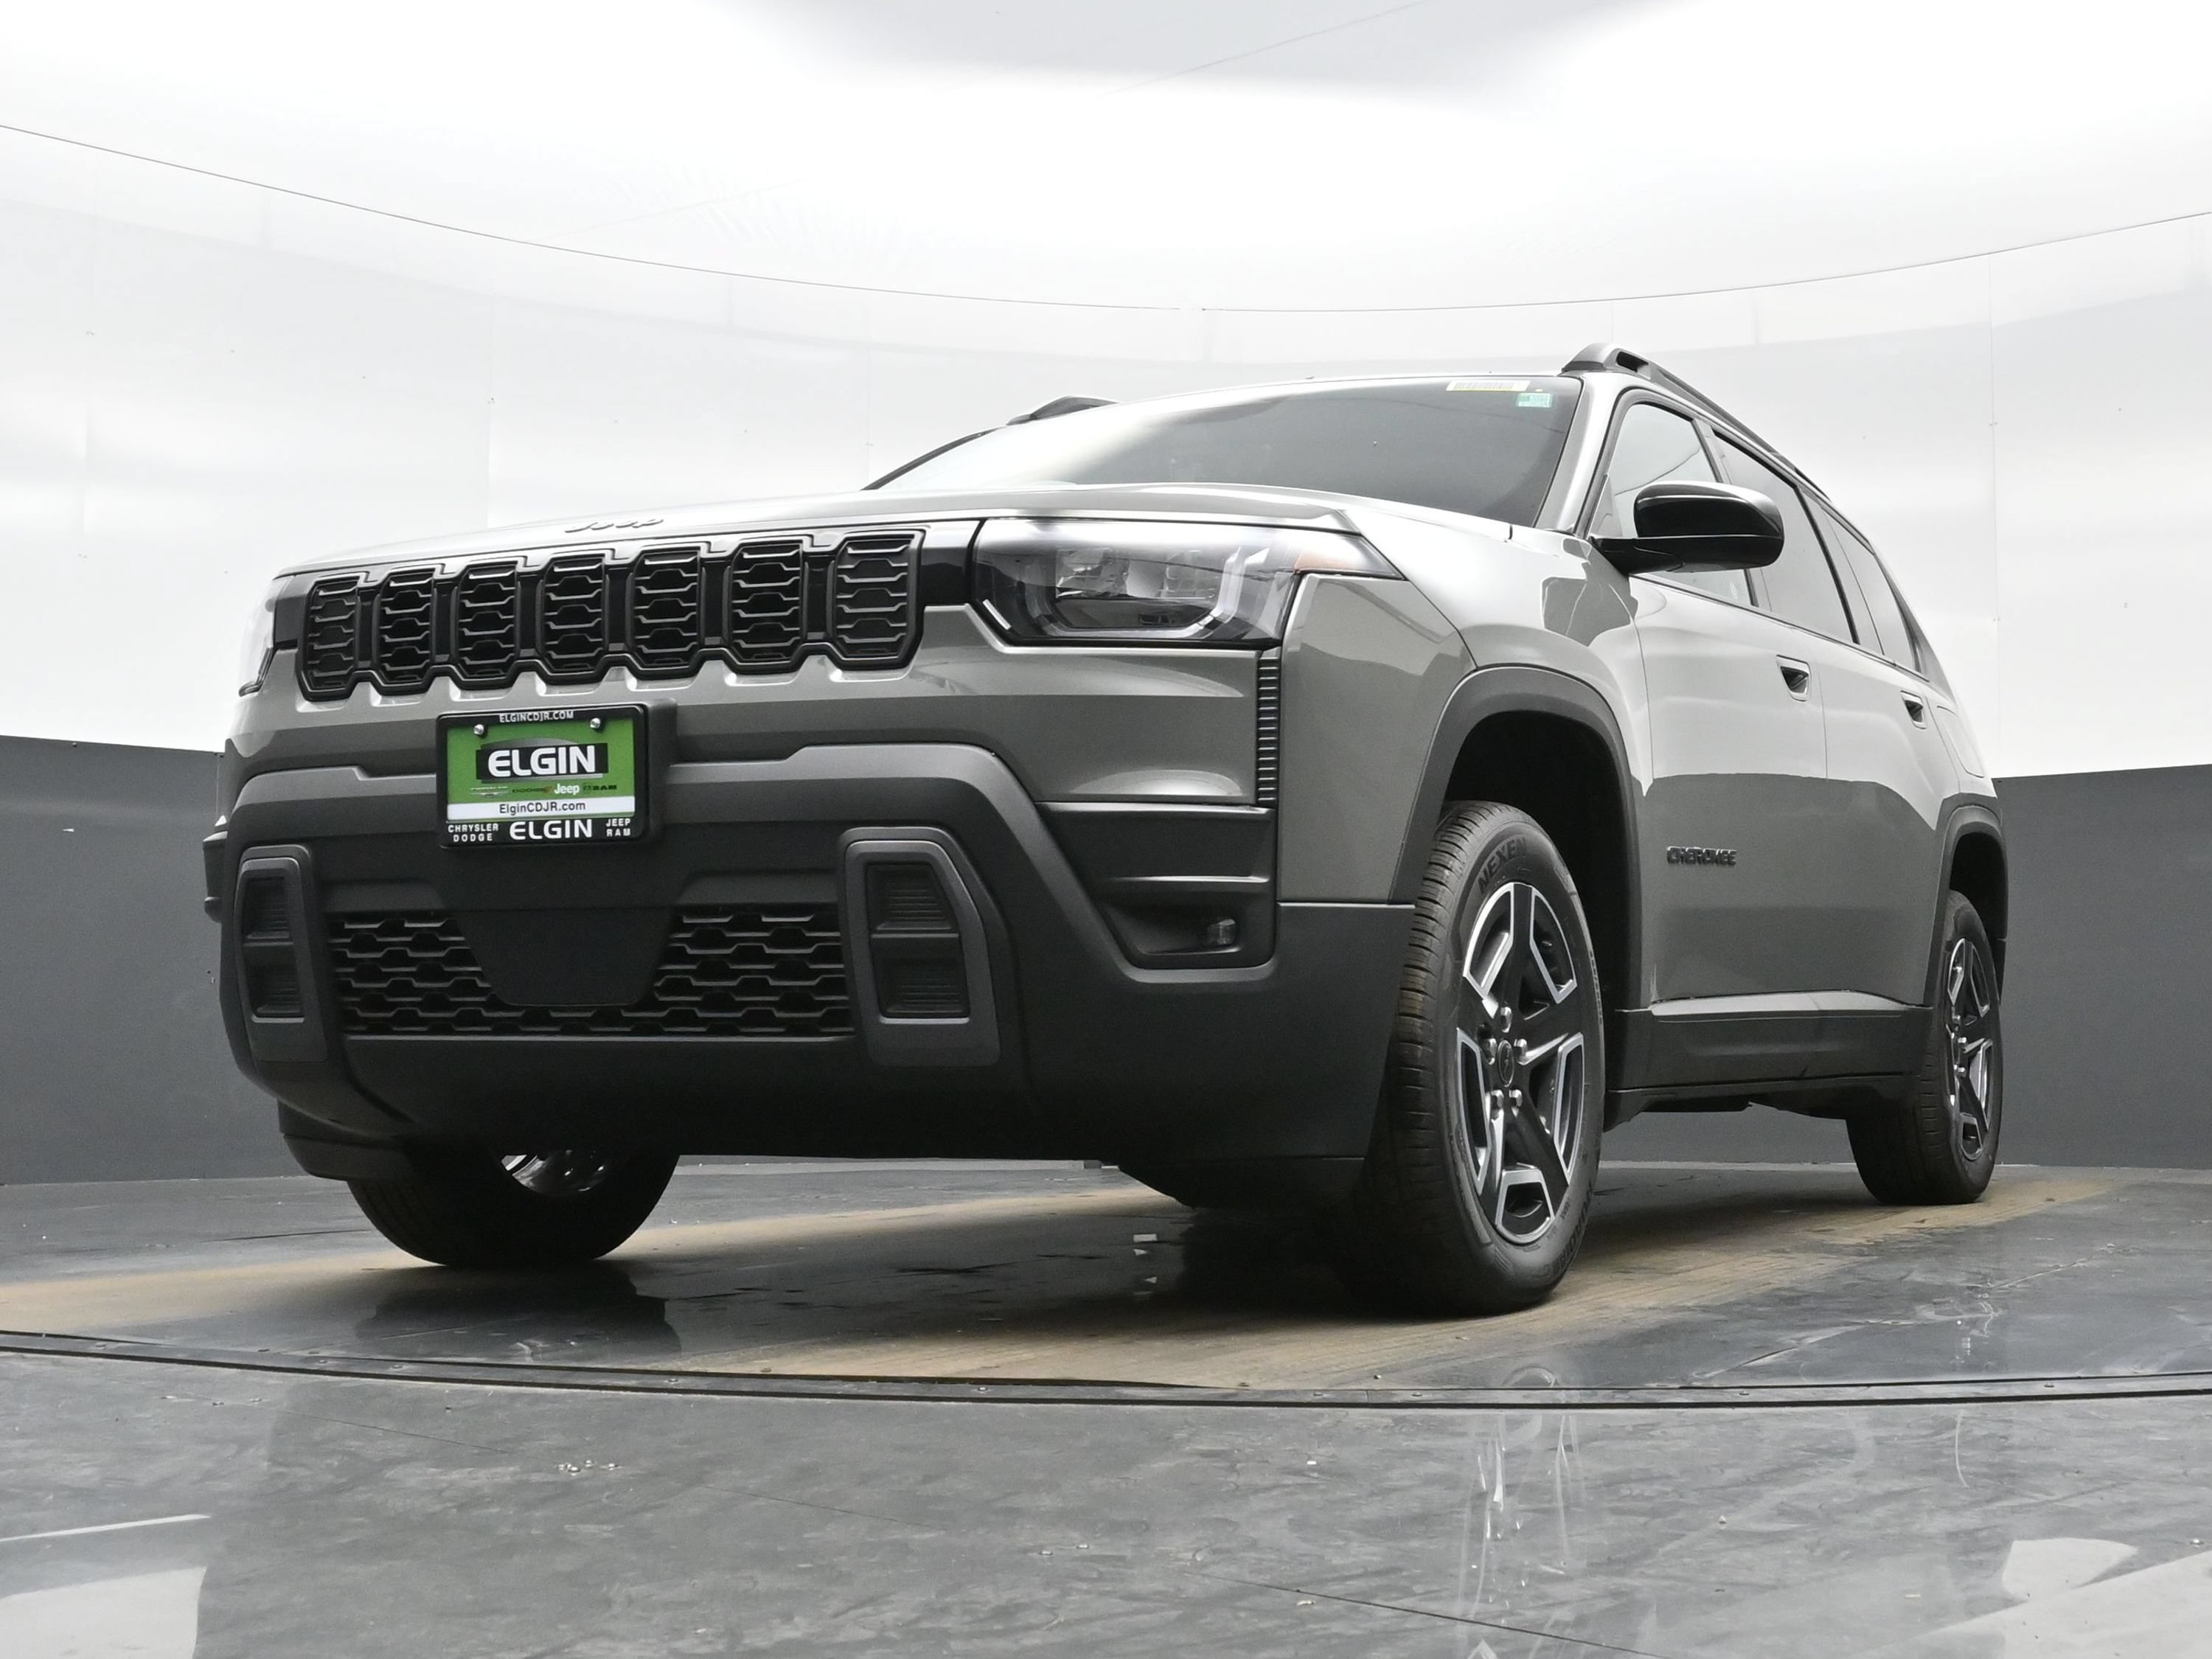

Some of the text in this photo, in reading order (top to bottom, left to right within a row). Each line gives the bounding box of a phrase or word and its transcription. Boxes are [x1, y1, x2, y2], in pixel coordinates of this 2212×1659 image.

[499, 710, 574, 723] ELGINCDJR.COM
[487, 745, 596, 777] ELGIN
[554, 783, 580, 796] Jeep
[499, 801, 586, 815] ElginCDJR.com
[448, 823, 499, 833] CHRYSLER
[605, 818, 631, 827] JEEP
[509, 819, 592, 841] ELGIN
[606, 828, 631, 837] RAM
[453, 833, 493, 843] DODGE
[1666, 846, 1738, 866] CHEROKEE
